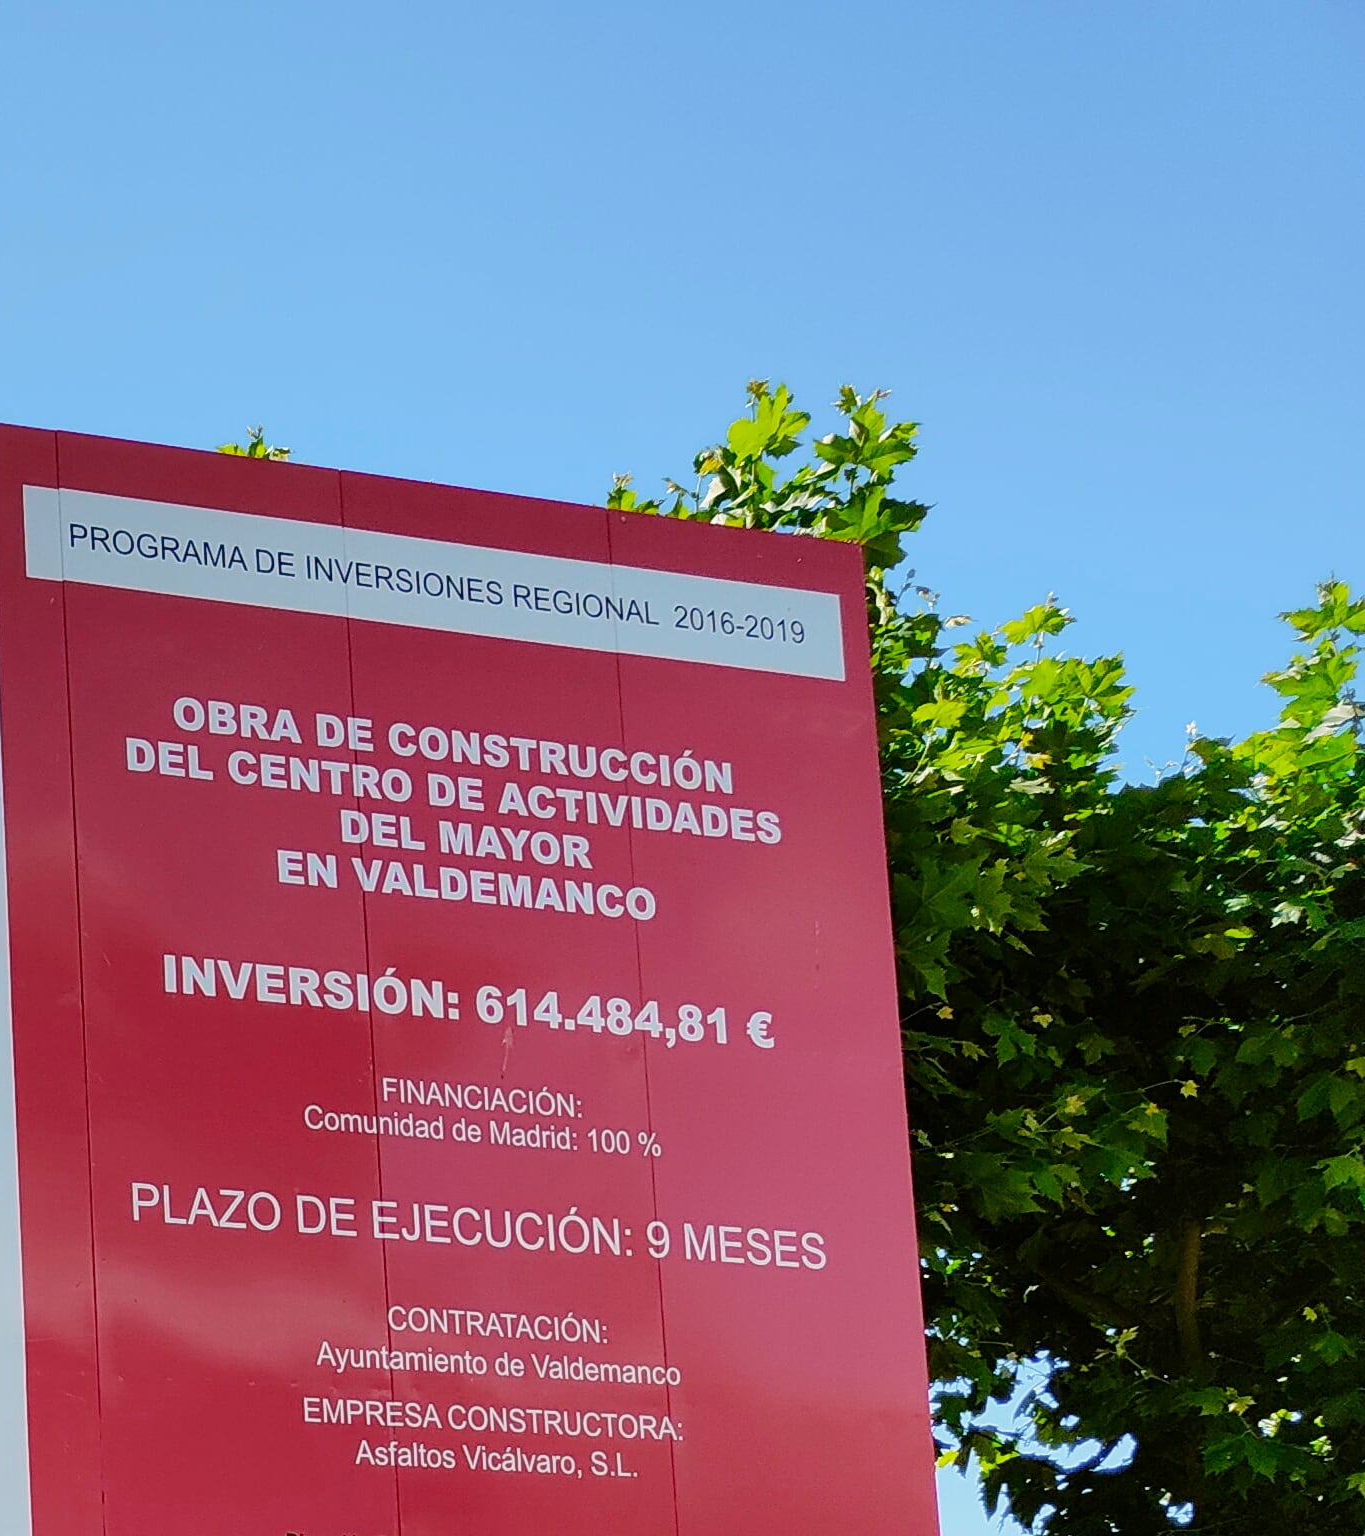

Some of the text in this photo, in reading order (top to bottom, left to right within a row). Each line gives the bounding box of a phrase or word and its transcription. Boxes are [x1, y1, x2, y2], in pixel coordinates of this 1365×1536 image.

[70, 524, 804, 643] PROGRAMA DE INVERSIONES REGIONAL 2016-2019
[173, 697, 733, 794] OBRA DE CONSTRUCCIÓN
[126, 737, 781, 844] DEL CENTRO DE ACTIVIDADES
[341, 809, 593, 869] DEL MAYOR
[277, 850, 656, 920] EN VALDEMANCO
[164, 954, 775, 1049] INVERSIÓN: 614.484,81 €
[383, 1077, 582, 1118] FINANCIACIÓN:
[304, 1105, 661, 1157] Comunidad de Madrid: 100 %
[132, 1182, 826, 1269] PLAZO DE EJECUCIÓN: 9 MESES
[388, 1306, 607, 1343] CONTRATACIÓN:
[317, 1341, 680, 1385] Ayuntamiento de Valdemanco
[304, 1397, 683, 1441] EMPRESA CONSTRUCTORA:
[355, 1440, 637, 1479] Asfaltos Vicálvaro, S.L.
